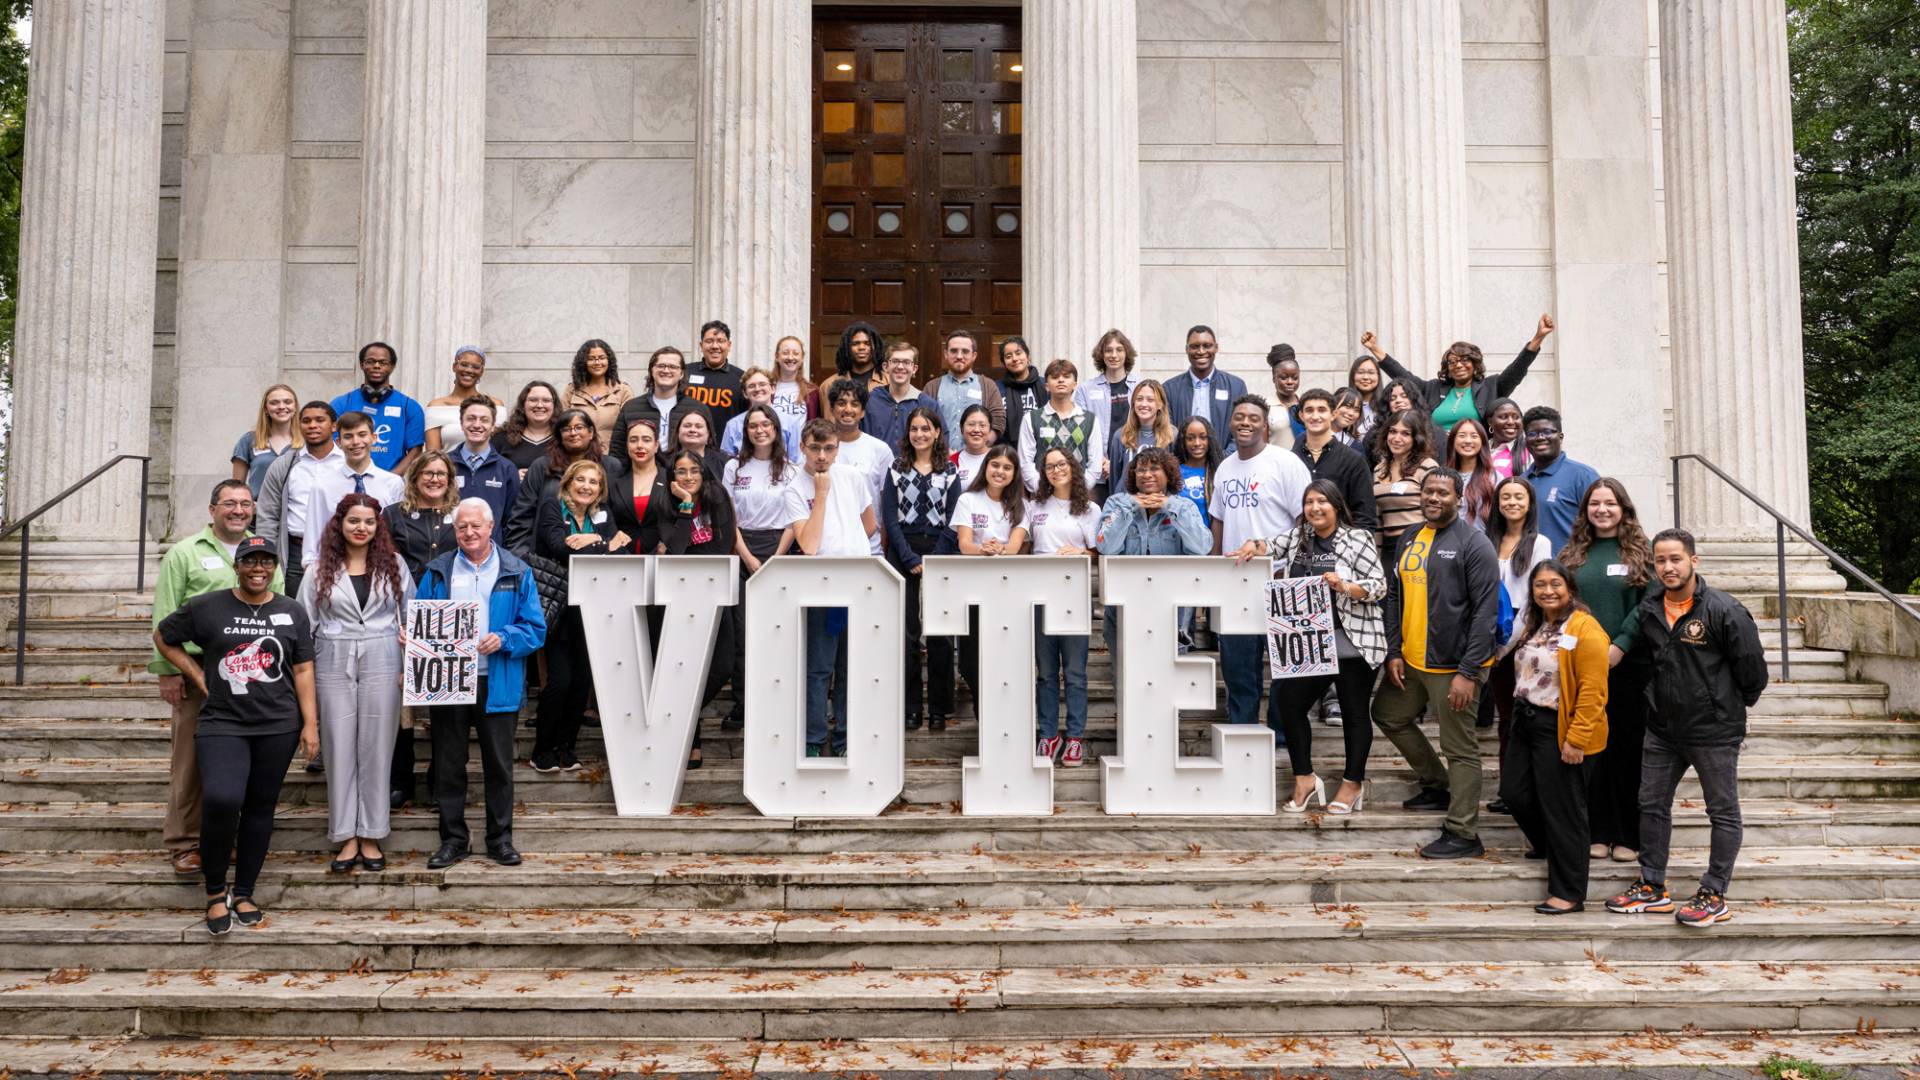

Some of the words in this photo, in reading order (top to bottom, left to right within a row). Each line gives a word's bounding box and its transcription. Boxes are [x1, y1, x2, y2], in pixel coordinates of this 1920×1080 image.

[1221, 492, 1259, 509] VOTES
[1271, 586, 1304, 617] ALL
[1305, 583, 1327, 615] IN
[233, 617, 266, 626] TEAM
[413, 608, 449, 640] ALL
[453, 608, 475, 640] IN
[1288, 618, 1311, 628] TO
[223, 627, 275, 636] CAMDEN
[431, 643, 456, 652] TO
[1274, 629, 1332, 667] VOTE
[228, 660, 272, 674] STRONG
[412, 656, 472, 693] VOTE
[568, 554, 1276, 817] VOTE
